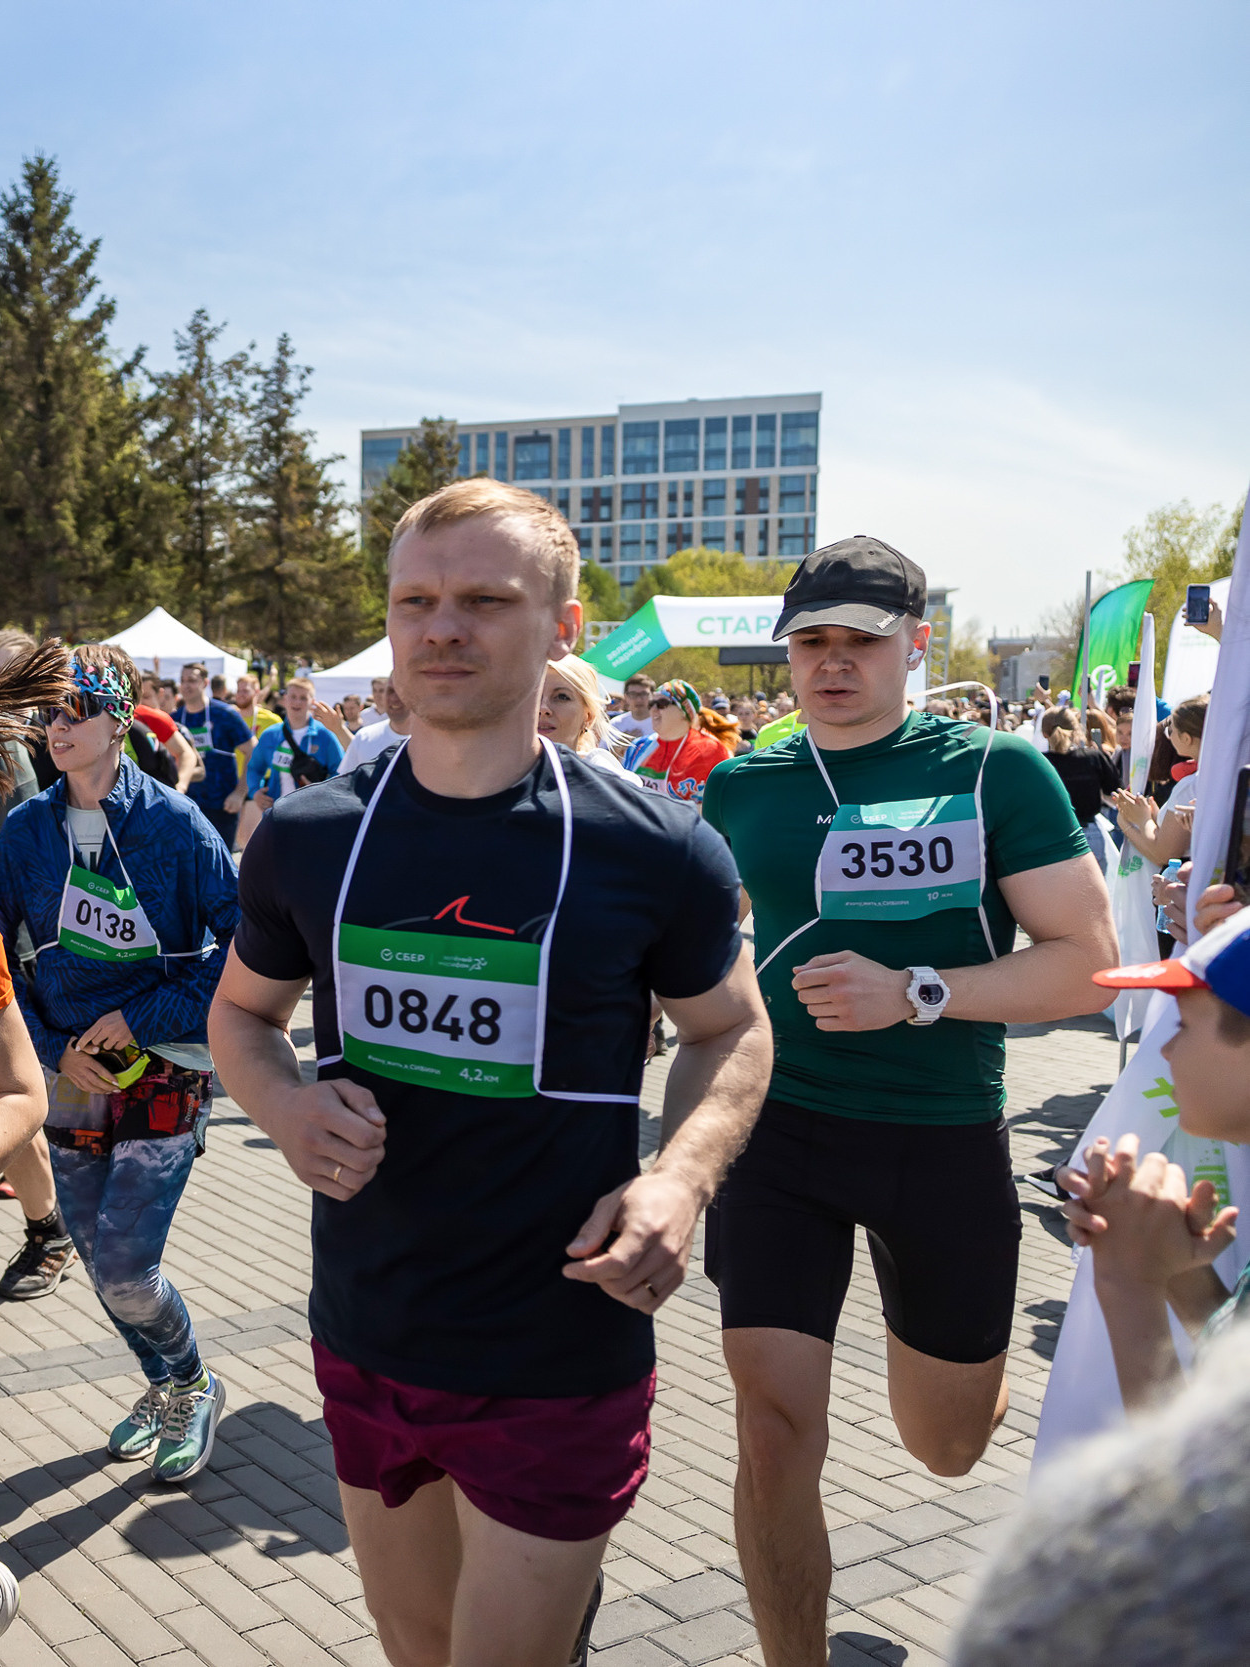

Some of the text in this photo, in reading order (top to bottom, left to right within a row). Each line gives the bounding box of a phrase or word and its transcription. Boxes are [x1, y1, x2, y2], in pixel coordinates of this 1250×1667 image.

[696, 616, 780, 635] СТАР
[841, 836, 954, 880] 3530
[76, 899, 136, 942] 0138
[395, 952, 425, 962] СБЕР
[364, 984, 502, 1046] 0848
